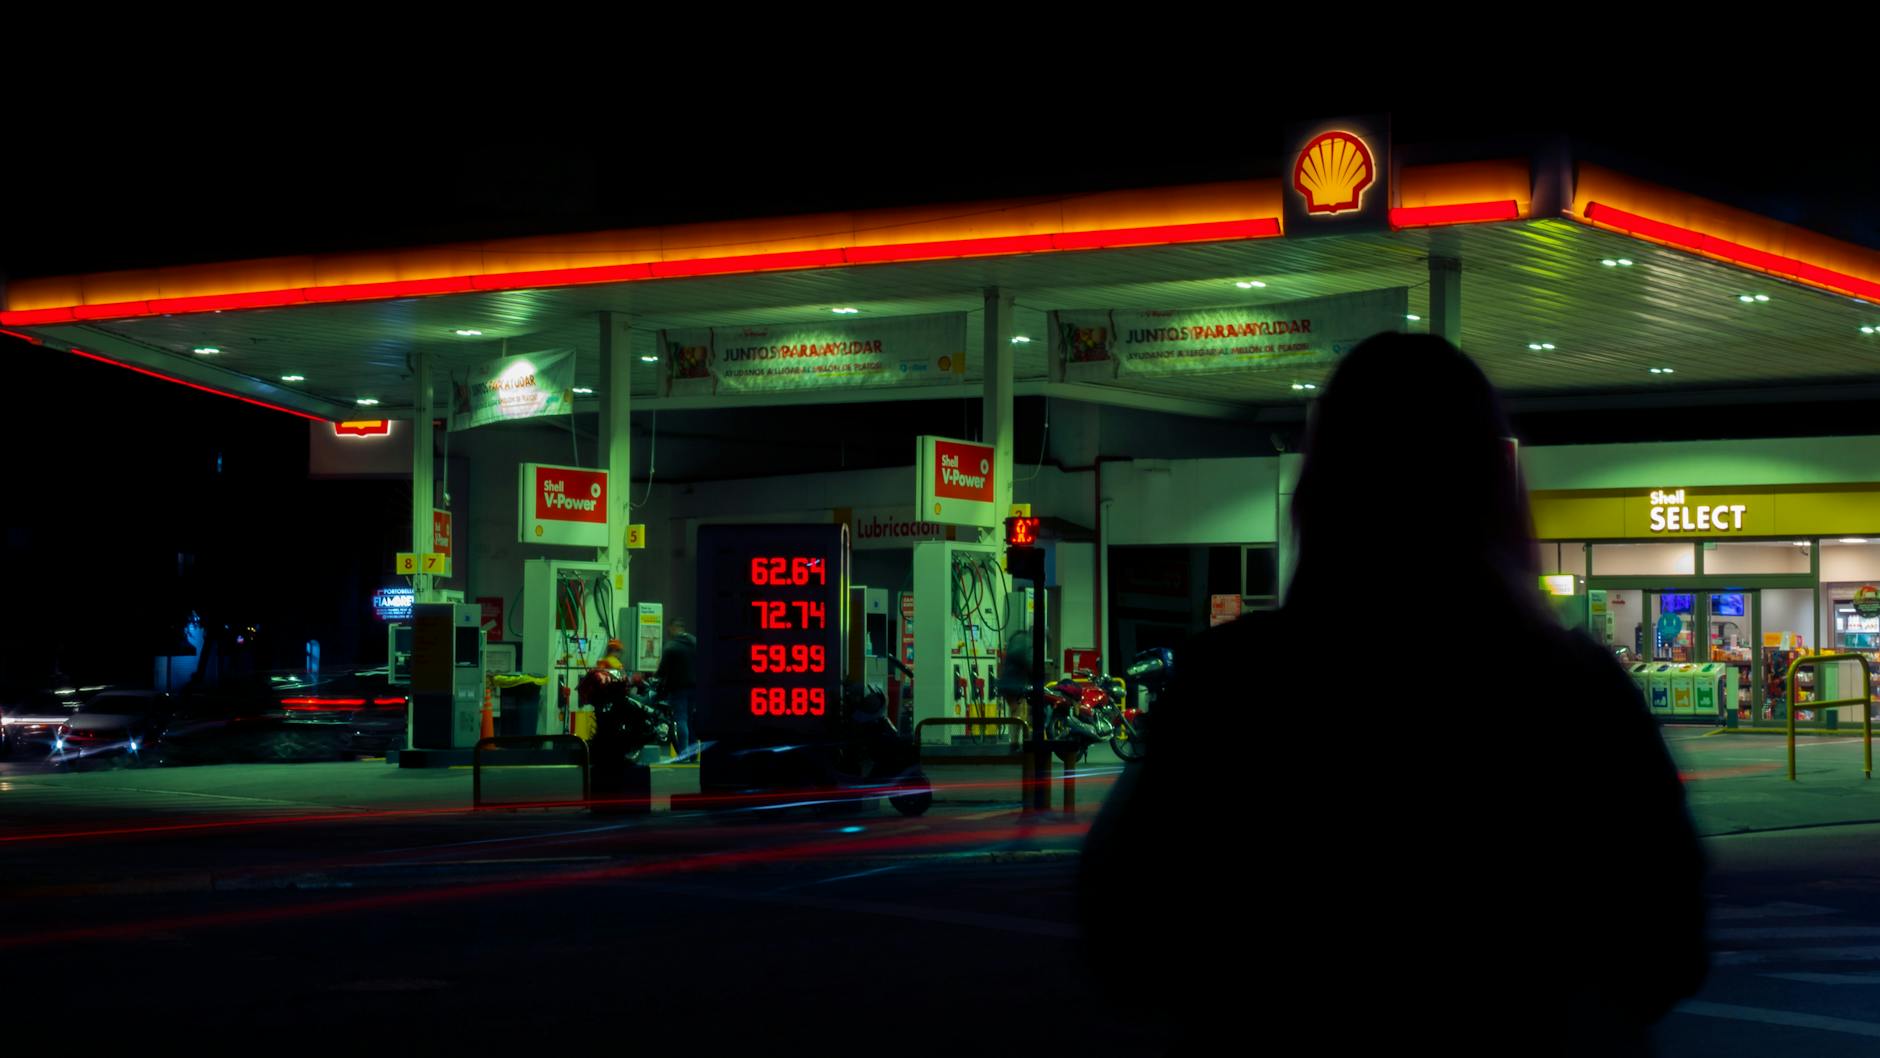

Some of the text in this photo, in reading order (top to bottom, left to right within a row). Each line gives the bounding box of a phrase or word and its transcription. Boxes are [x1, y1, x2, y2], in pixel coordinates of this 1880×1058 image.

[1126, 319, 1311, 343] JUNTOS PARA AYUDAR
[723, 340, 882, 362] JUNTOS PARA AYUDAR
[942, 454, 959, 468] Shell
[544, 480, 564, 492] Shell
[942, 468, 986, 489] V-Power
[544, 493, 597, 511] V-Power
[1650, 490, 1685, 505] Shell
[1650, 505, 1746, 531] SELECT
[631, 530, 638, 544] 5
[404, 558, 413, 570] 8
[428, 558, 437, 570] 7
[751, 556, 826, 586] 62.64
[751, 601, 826, 630] 72.74
[751, 644, 826, 673] 59.99
[750, 687, 826, 716] 68.89
